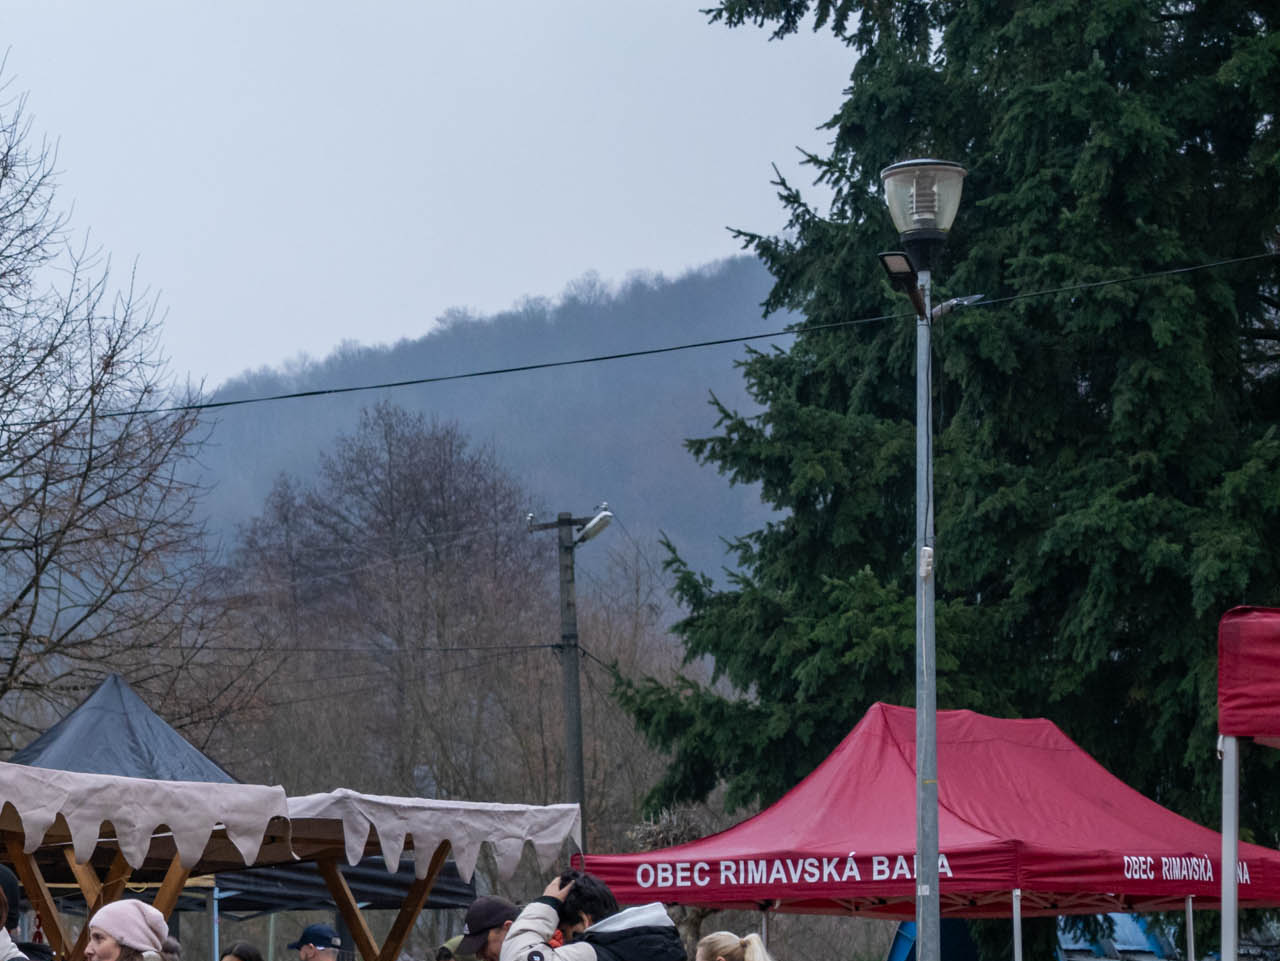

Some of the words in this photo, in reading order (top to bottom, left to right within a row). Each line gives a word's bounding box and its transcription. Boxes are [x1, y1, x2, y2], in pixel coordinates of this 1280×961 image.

[636, 861, 711, 888] OBEC
[719, 851, 861, 885] RIMAVSKÁ
[1123, 855, 1155, 880] OBEC
